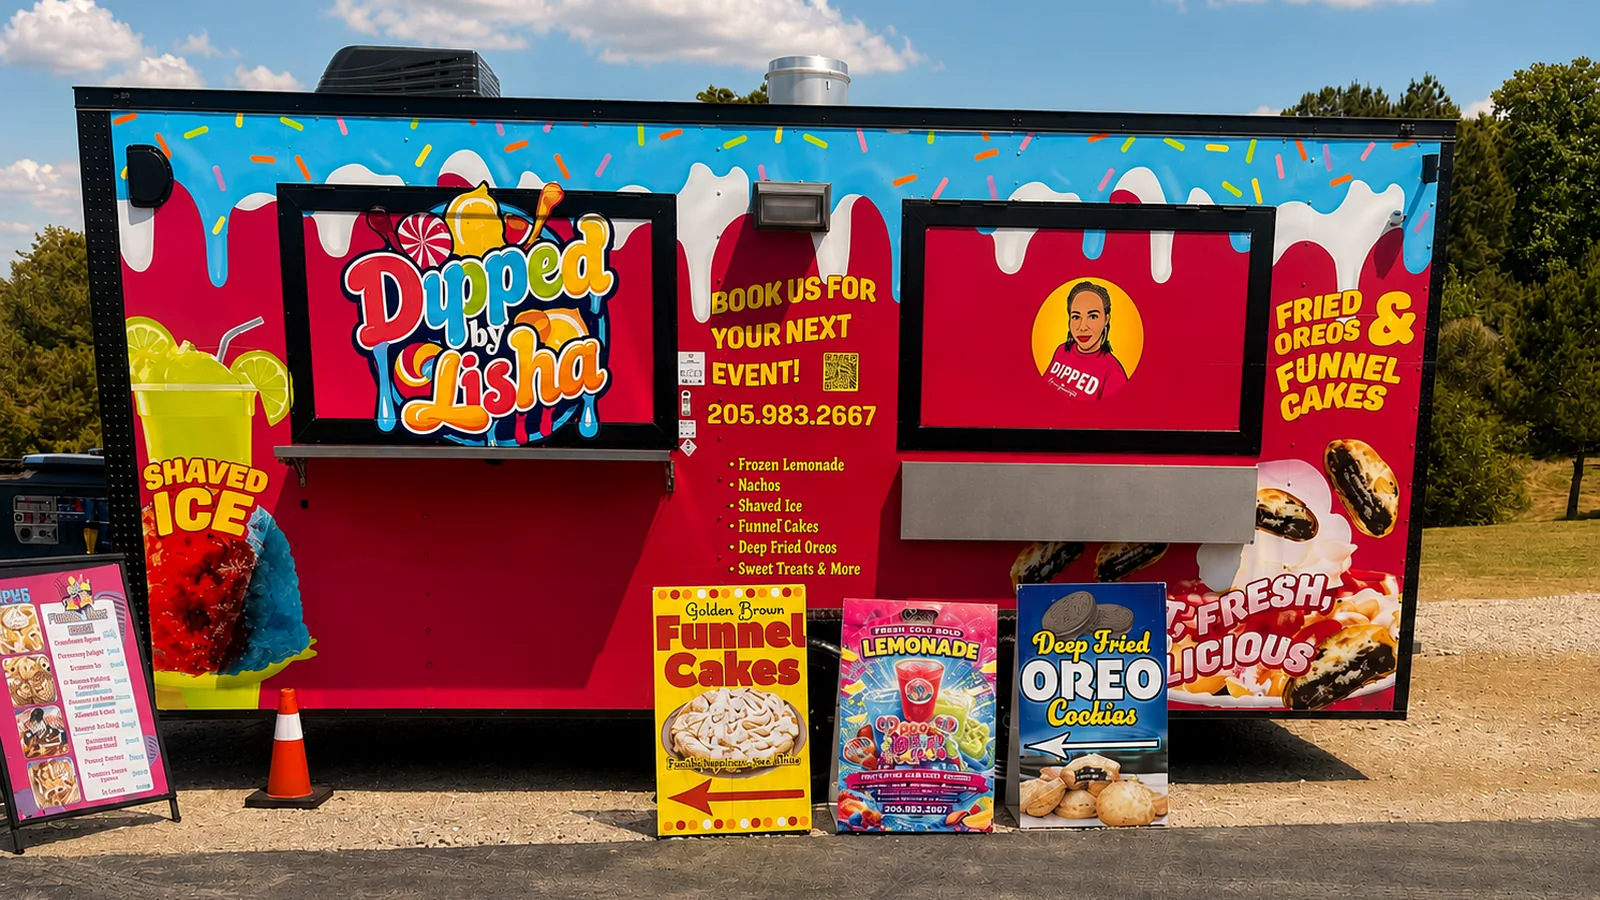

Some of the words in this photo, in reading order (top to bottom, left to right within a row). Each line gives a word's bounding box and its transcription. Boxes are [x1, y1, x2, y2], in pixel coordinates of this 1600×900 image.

[711, 280, 782, 315] BOOK
[787, 276, 822, 303] US
[827, 275, 877, 303] FOR
[1275, 289, 1363, 329] FRIED
[469, 319, 506, 354] by
[711, 322, 781, 349] YOUR
[786, 313, 852, 344] NEXT
[1368, 291, 1416, 346] &
[1274, 319, 1361, 356] OREOS
[401, 326, 608, 434] Lisha
[712, 358, 800, 386] EVENT!
[1050, 361, 1099, 395] DIPPED
[1275, 351, 1401, 393] FUNNEL
[707, 403, 877, 426] 205.983.2667
[1280, 382, 1388, 422] CAKES
[143, 457, 269, 493] SHAVED
[738, 458, 779, 471] Frozen
[783, 457, 845, 471] Lemonade
[738, 477, 781, 492] Nachos
[153, 487, 255, 537] ICE
[738, 498, 781, 512] Shaved
[785, 499, 802, 512] Ice
[738, 519, 782, 533] Funnel
[784, 519, 819, 533] Cakes
[738, 540, 767, 556] Deep
[771, 539, 801, 554] Fried
[805, 540, 837, 554] Oreos
[738, 562, 773, 575] Sweet
[776, 562, 814, 575] Treats
[818, 562, 826, 575] &
[830, 562, 861, 575] More
[685, 602, 734, 620] Golden
[738, 601, 785, 620] Brown
[1198, 573, 1332, 636] FRESH,
[657, 613, 806, 651] Funnel
[862, 637, 980, 660] LEMONADE
[1032, 630, 1088, 662] Deep
[1093, 629, 1151, 654] Fried
[664, 651, 801, 688] Cakes
[1021, 659, 1163, 701] OREO
